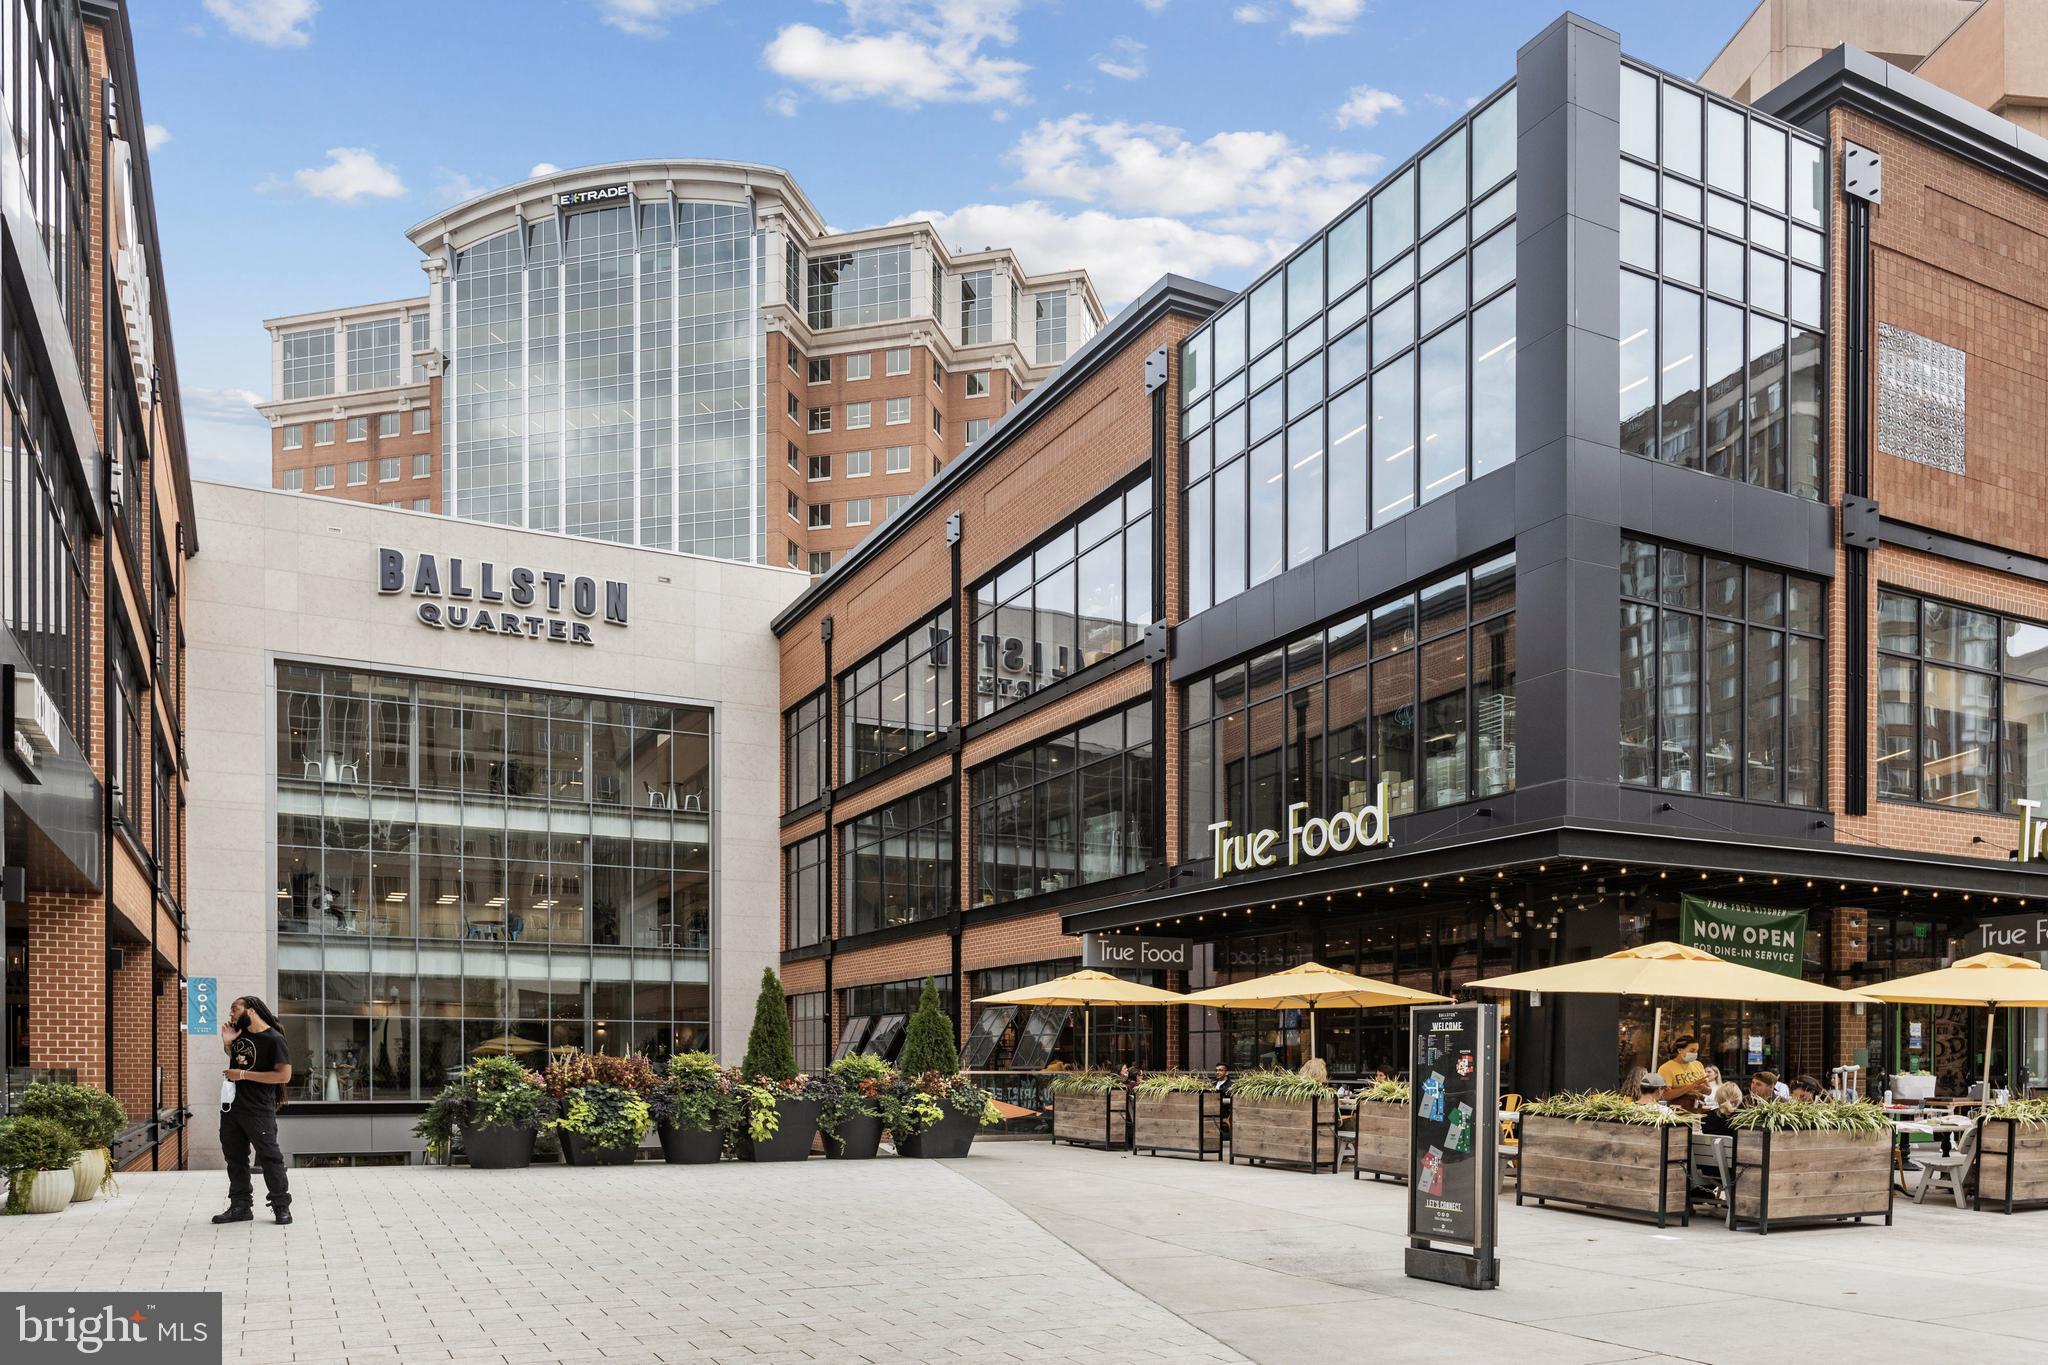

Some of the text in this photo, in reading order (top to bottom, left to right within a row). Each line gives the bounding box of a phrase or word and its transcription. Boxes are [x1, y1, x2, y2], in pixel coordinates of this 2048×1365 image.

[378, 547, 628, 626] BALLSTON
[417, 602, 594, 645] QUARTER
[1208, 782, 1389, 879] True Food
[1707, 900, 1788, 917] TRUE FOOD KITCHEN
[1694, 920, 1795, 948] NOW OPEN
[1979, 923, 2028, 948] True
[1098, 940, 1184, 962] True Food
[1694, 943, 1795, 962] FOR DINE-IN SERVICE
[197, 983, 208, 1024] COPA
[1432, 1022, 1463, 1030] WELCOME
[1426, 1199, 1462, 1211] LET'S CONNECT
